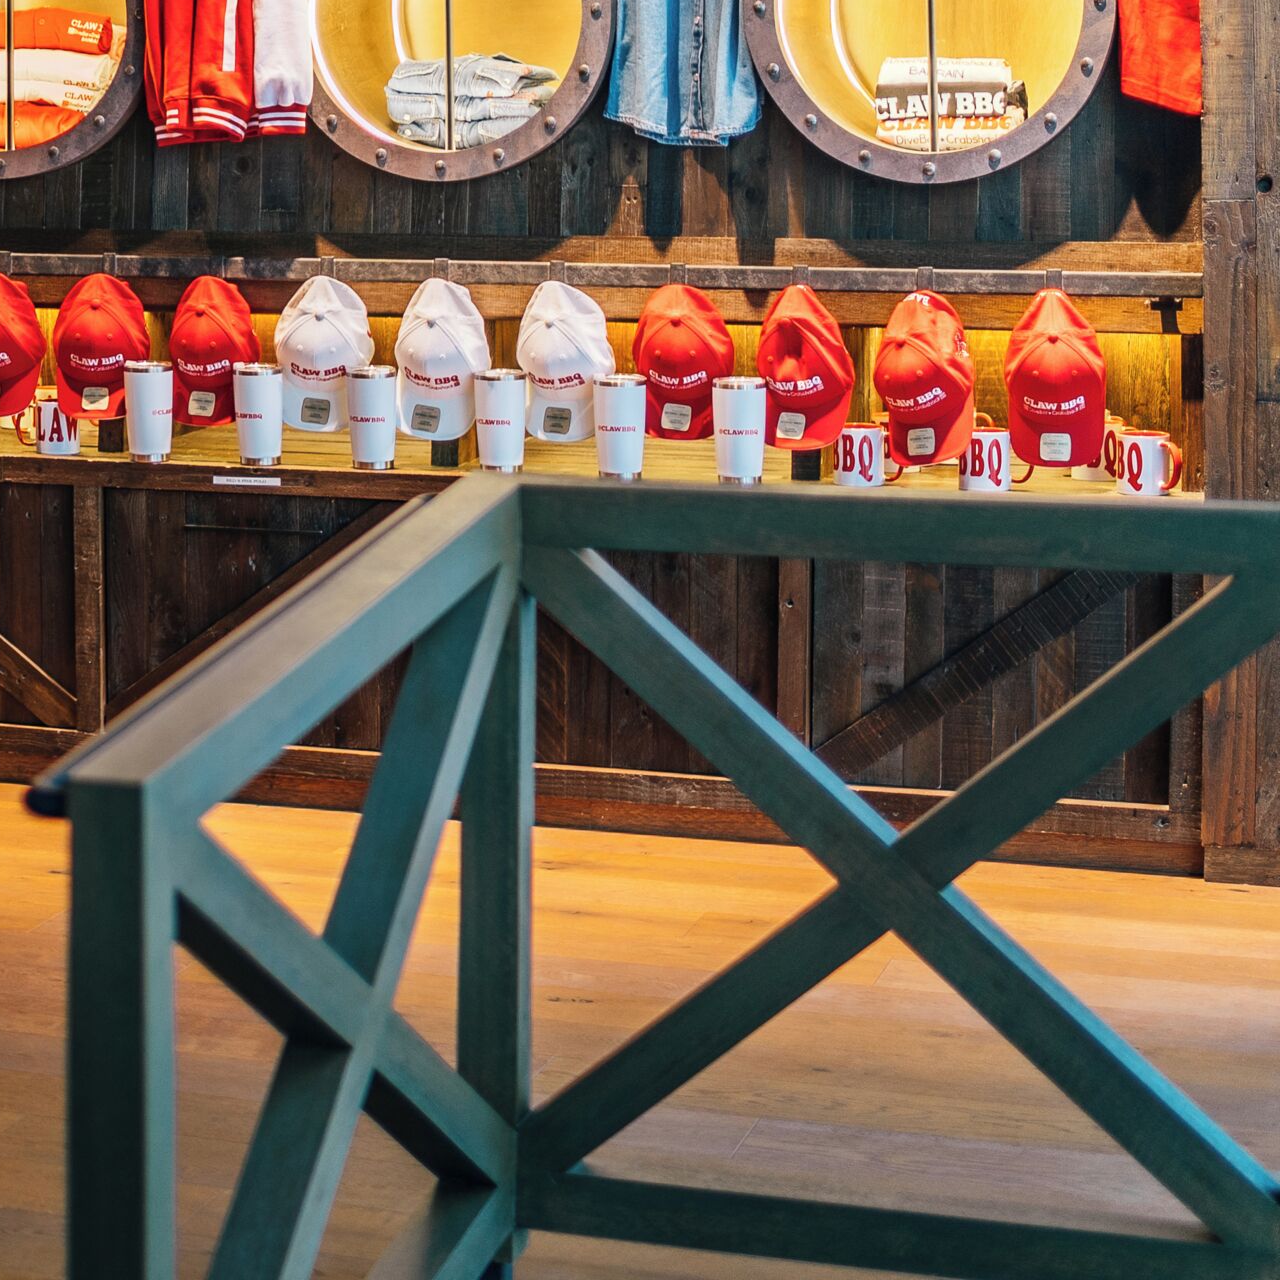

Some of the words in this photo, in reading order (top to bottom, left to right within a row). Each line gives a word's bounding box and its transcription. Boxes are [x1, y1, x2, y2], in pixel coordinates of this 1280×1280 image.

[70, 19, 98, 31] CLAW
[908, 66, 965, 79] BARAIN
[64, 92, 94, 102] CLAW
[875, 91, 951, 121] CLAW
[70, 353, 99, 367] CLAW
[101, 353, 124, 366] BBQ
[177, 358, 204, 372] CLAW
[206, 359, 231, 372] BBQ
[290, 362, 321, 376] CLAW
[323, 364, 347, 376] BBQ
[404, 366, 432, 384] CLAW
[527, 371, 556, 386] CLAW
[558, 372, 583, 386] BBQ
[648, 368, 680, 386] CLAW
[682, 369, 708, 385] BBQ
[765, 375, 796, 392] CLAW
[796, 375, 823, 391] BBQ
[885, 394, 915, 408] CLAW
[916, 385, 944, 405] BBQ
[1023, 395, 1058, 411] CLAW
[1060, 395, 1085, 411] BBQ
